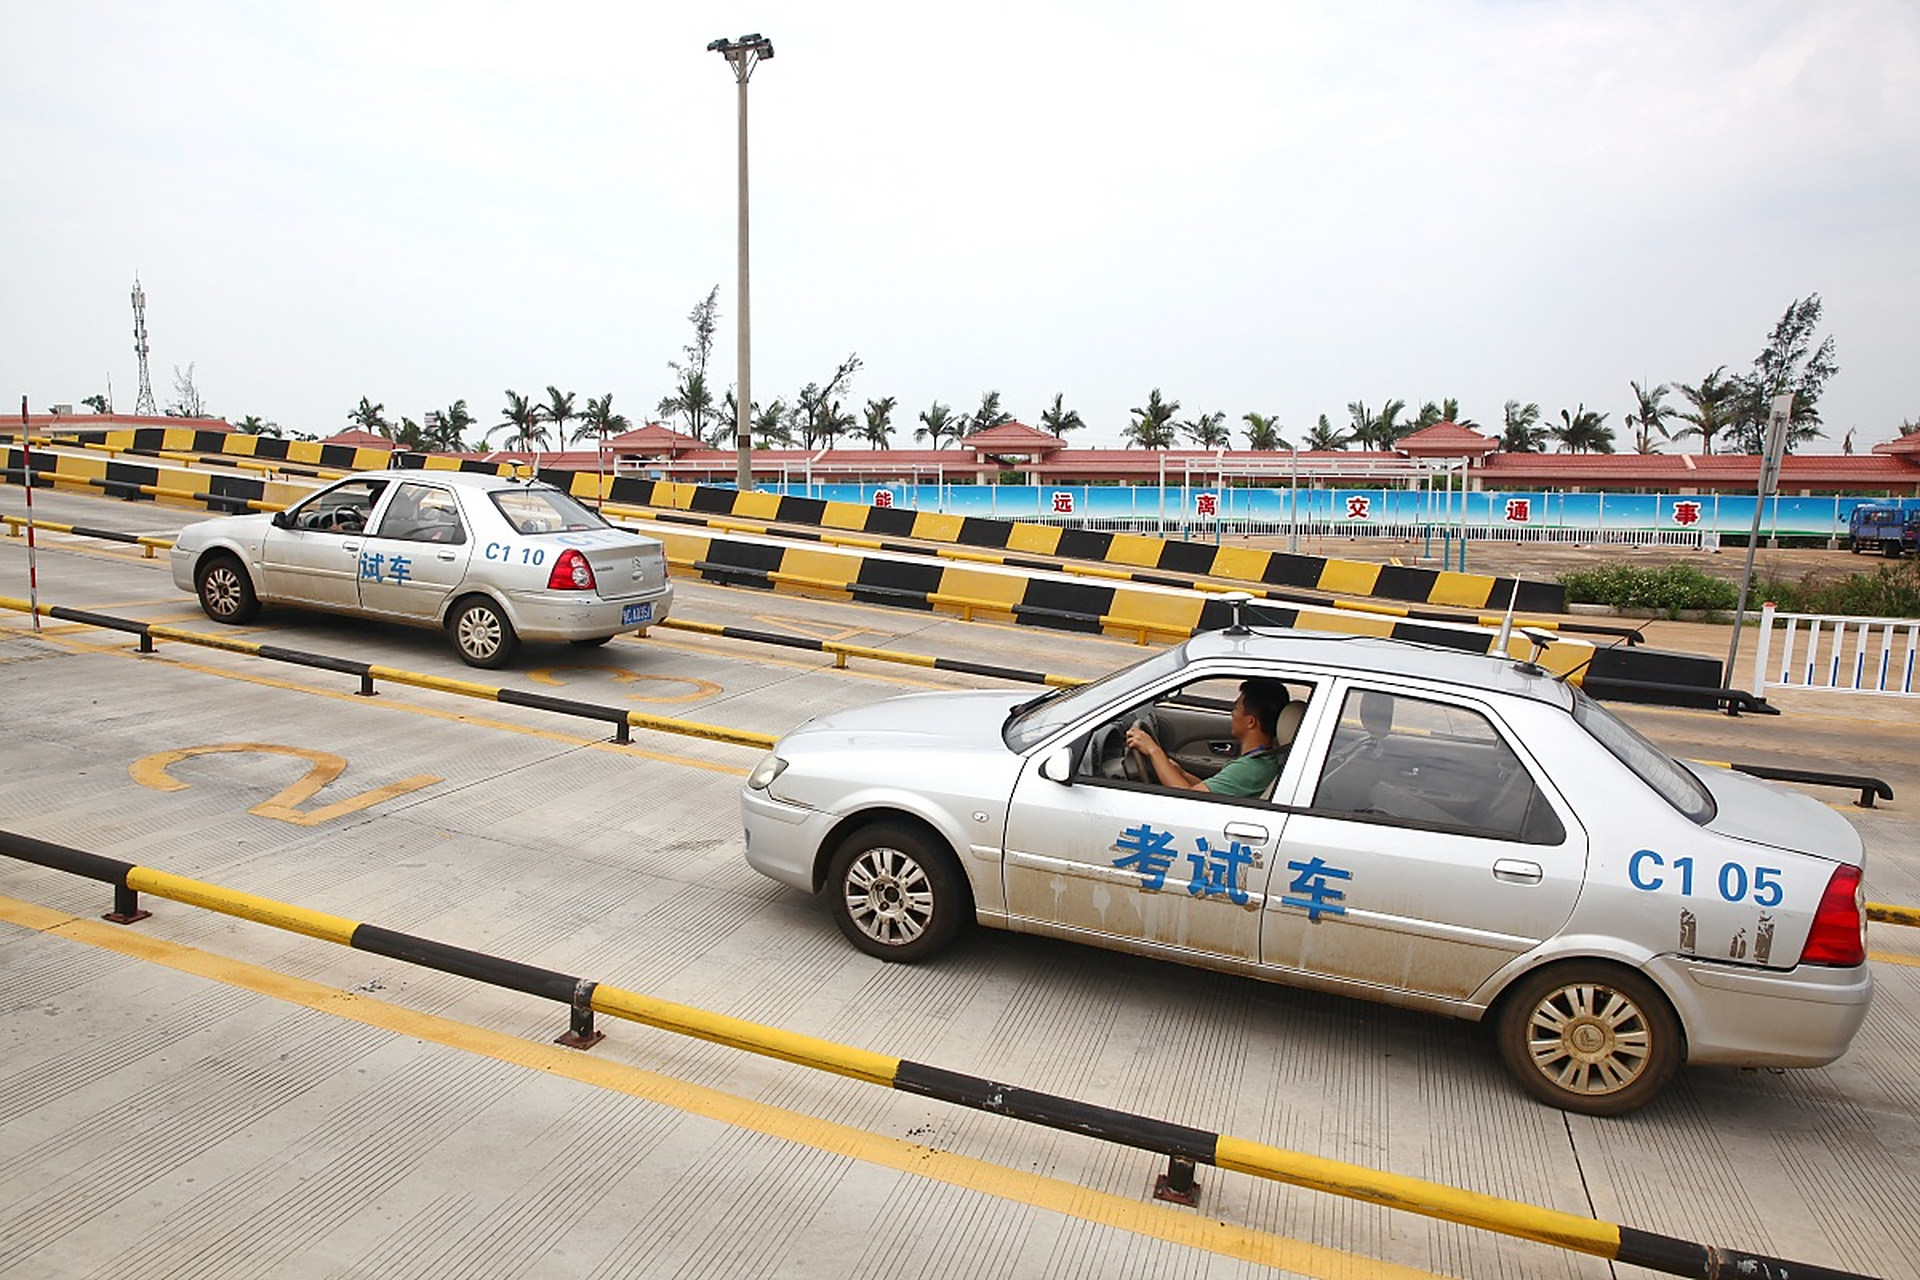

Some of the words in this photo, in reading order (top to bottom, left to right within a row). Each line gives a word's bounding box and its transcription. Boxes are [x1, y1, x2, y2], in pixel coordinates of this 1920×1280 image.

[1053, 494, 1073, 514] 远
[1197, 494, 1217, 515] 离
[1348, 497, 1368, 518] 交
[1506, 500, 1529, 523] 通
[1673, 503, 1699, 526] 事
[360, 552, 412, 585] 试车
[485, 542, 511, 562] C1
[522, 548, 545, 565] 10
[525, 663, 724, 705] 3
[127, 741, 446, 827] 2
[1111, 823, 1352, 921] 考试车
[1628, 849, 1694, 897] C1
[1718, 862, 1784, 908] 05
